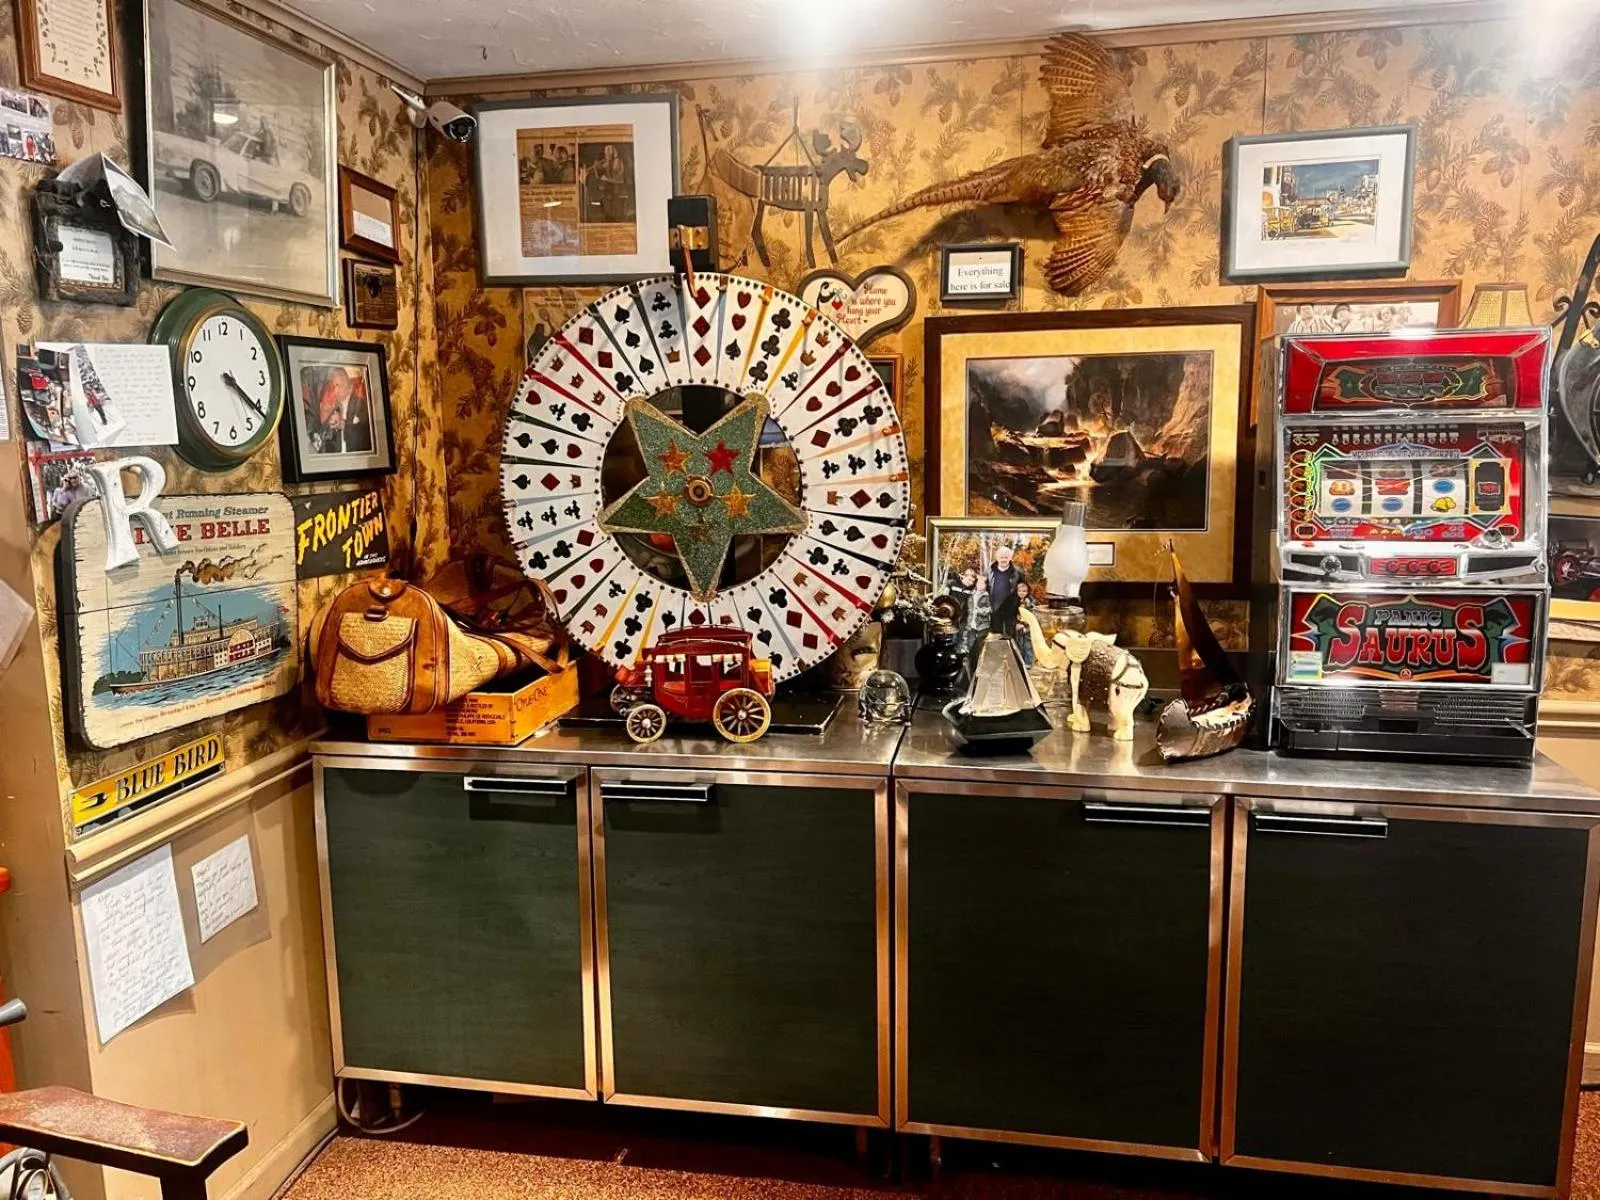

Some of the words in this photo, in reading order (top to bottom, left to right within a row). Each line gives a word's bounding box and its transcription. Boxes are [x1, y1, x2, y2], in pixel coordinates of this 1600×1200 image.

[958, 266, 1004, 279] Everything
[863, 282, 888, 295] Home
[950, 283, 969, 292] here
[970, 282, 978, 290] is
[980, 281, 992, 290] for
[993, 279, 1011, 289] sale
[860, 296, 881, 306] where
[883, 298, 897, 308] you
[865, 307, 882, 317] your
[202, 328, 212, 342] 11
[218, 321, 229, 336] 12
[190, 350, 203, 364] 10
[250, 347, 257, 361] 2
[188, 376, 196, 392] 9
[258, 370, 266, 386] 3
[197, 401, 206, 419] 8
[255, 399, 262, 411] 4
[213, 421, 220, 435] 7
[245, 417, 253, 431] 5
[229, 425, 238, 440] 6
[84, 456, 181, 571] R
[176, 507, 222, 519] Running
[223, 506, 270, 516] Steamer
[200, 518, 271, 540] BELLE
[296, 490, 379, 566] FRONTIER
[342, 512, 384, 569] TOWN
[1374, 608, 1442, 627] PANIC
[1328, 603, 1487, 671] SAURUS
[115, 761, 166, 802] BLUE
[174, 739, 218, 778] BIRD
